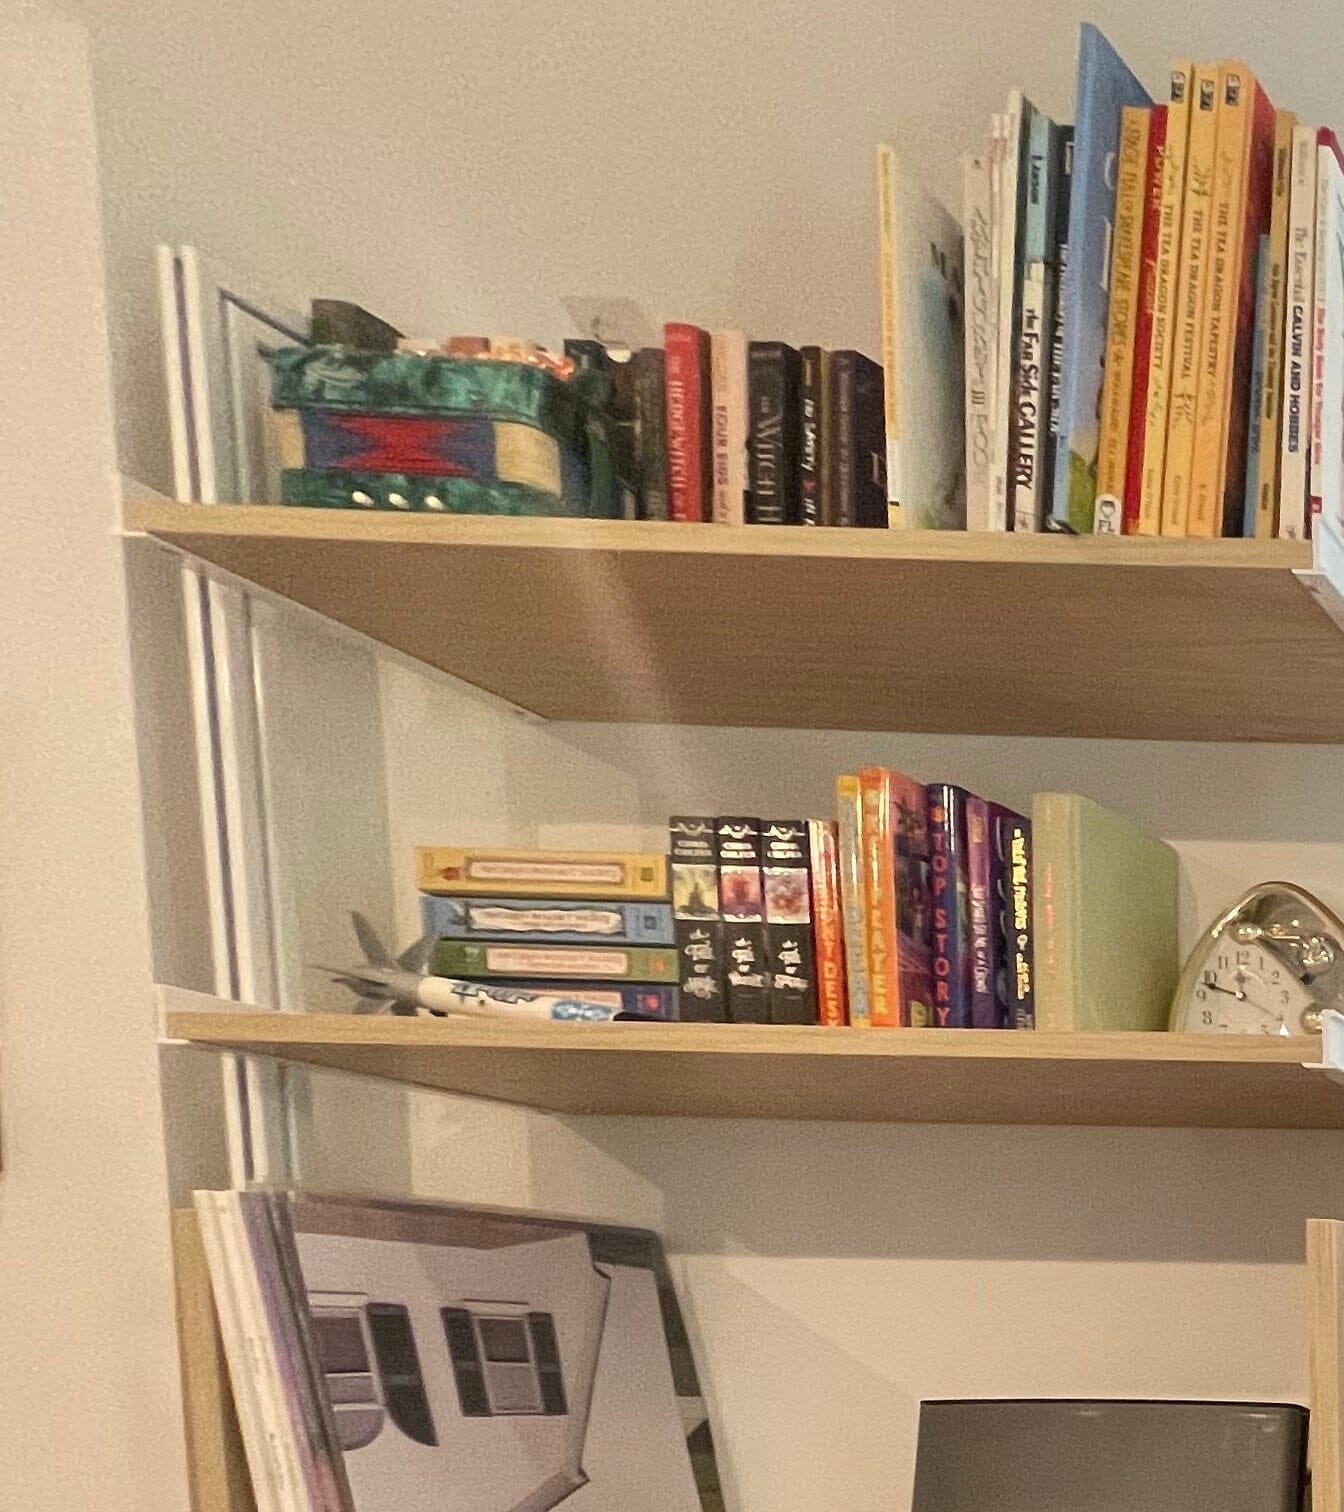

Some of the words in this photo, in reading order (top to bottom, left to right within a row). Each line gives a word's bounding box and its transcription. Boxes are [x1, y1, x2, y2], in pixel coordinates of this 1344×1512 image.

[1164, 204, 1174, 228] THE
[1192, 209, 1204, 234] THE
[1218, 202, 1230, 226] THE
[1161, 233, 1172, 255] TEA
[1191, 238, 1202, 260] TEA
[1217, 230, 1228, 253] TEA
[1158, 260, 1171, 314] DRAGON
[1186, 265, 1200, 318] DRAGON
[1212, 257, 1227, 311] DRAGON
[1155, 317, 1167, 369] SOCIETY
[1181, 322, 1194, 379] FESTIVAL
[1207, 317, 1221, 376] TAPESTRY
[1291, 305, 1304, 356] CALVIN
[1290, 361, 1302, 390] AND
[1288, 394, 1300, 453] HOBBES
[1016, 402, 1036, 489] GALLERY
[933, 833, 948, 896] TOP
[933, 909, 949, 1026] STORY
[1236, 951, 1249, 965] 12
[1196, 990, 1206, 1001] 9
[1280, 991, 1289, 1004] 3
[1202, 1011, 1213, 1025] 8
